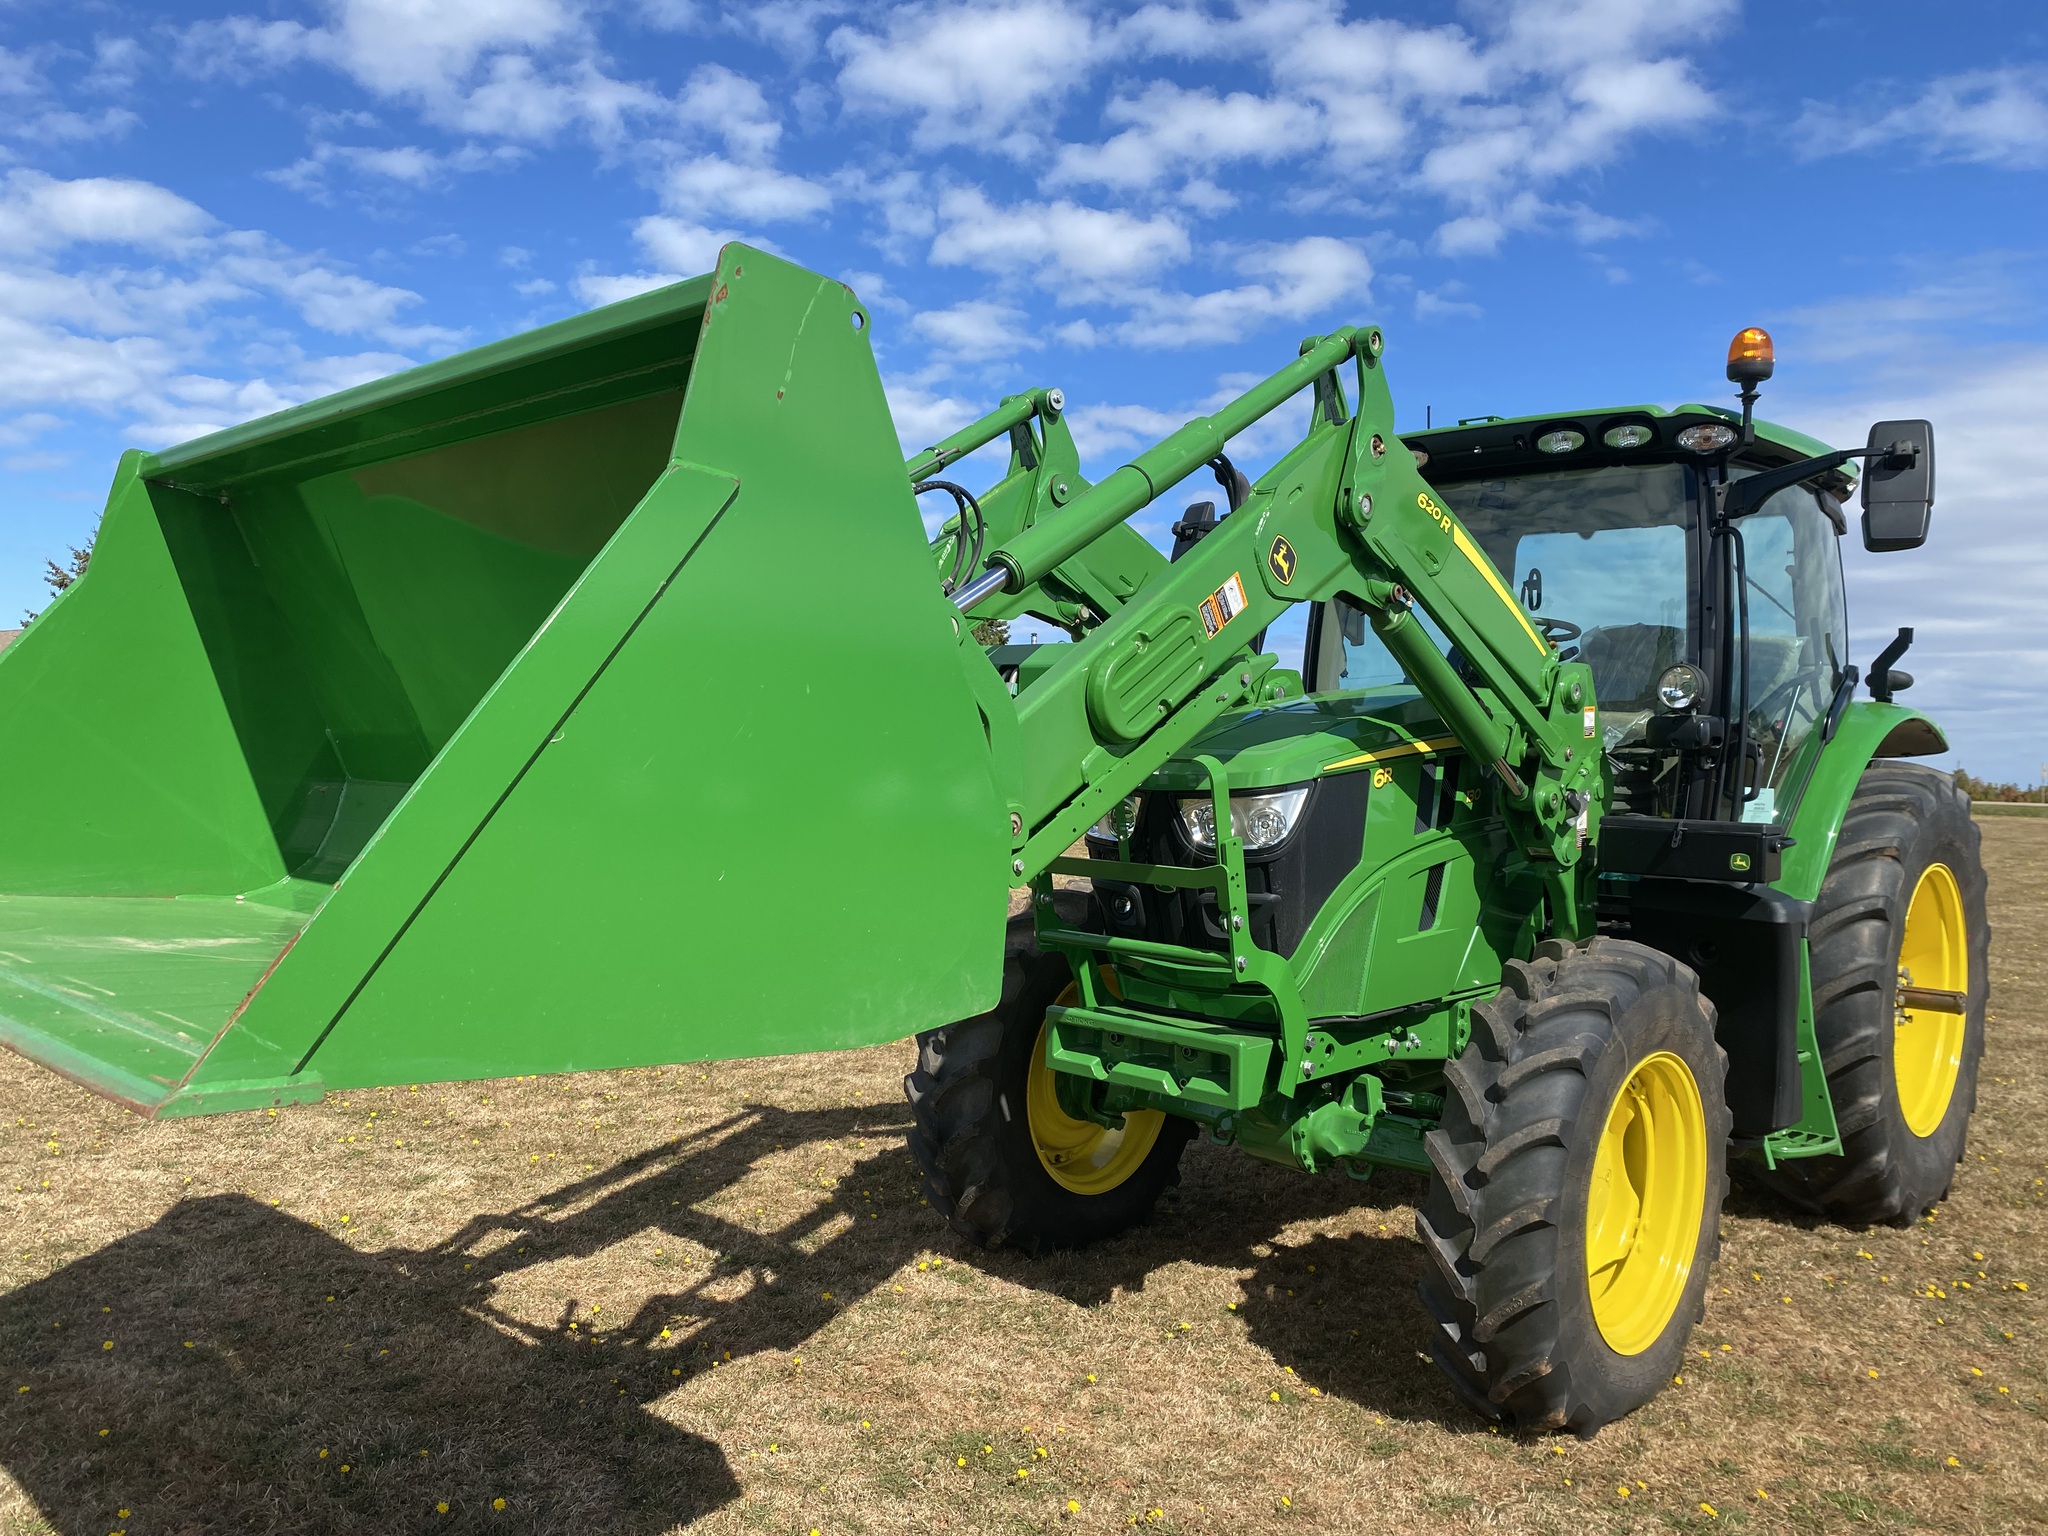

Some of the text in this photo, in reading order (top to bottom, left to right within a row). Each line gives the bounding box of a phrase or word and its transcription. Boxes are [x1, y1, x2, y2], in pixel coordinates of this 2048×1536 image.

[1417, 492, 1452, 535] 620 R
[1373, 767, 1393, 789] 6R
